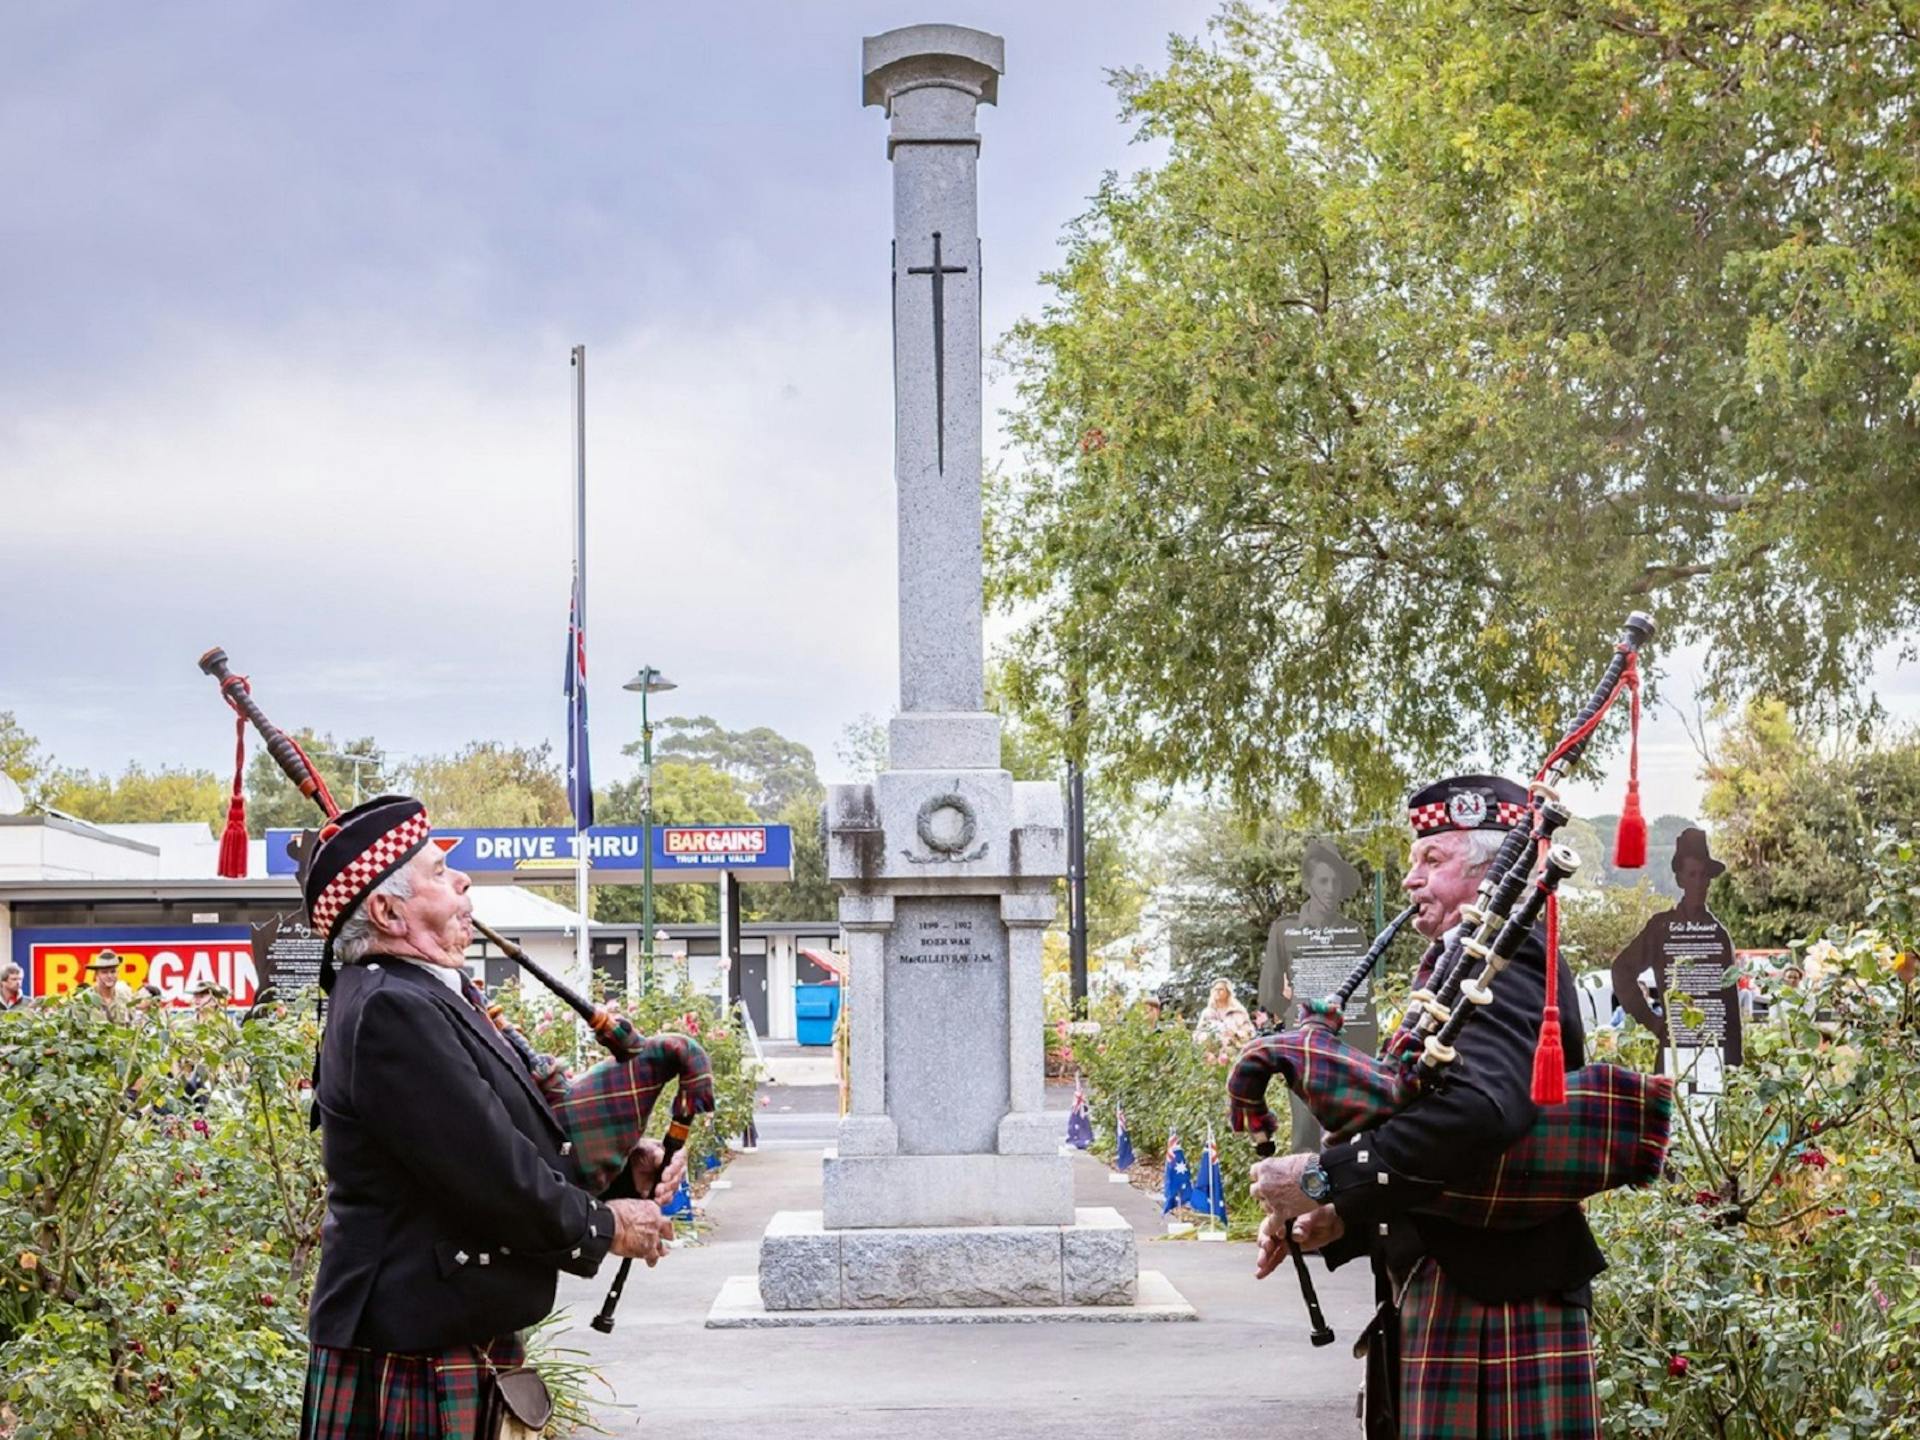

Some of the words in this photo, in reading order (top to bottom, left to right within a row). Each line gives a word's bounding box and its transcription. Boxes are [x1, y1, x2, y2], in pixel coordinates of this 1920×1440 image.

[476, 836, 555, 858] DRIVE
[566, 835, 638, 857] THRU
[668, 831, 764, 851] BARGAINS
